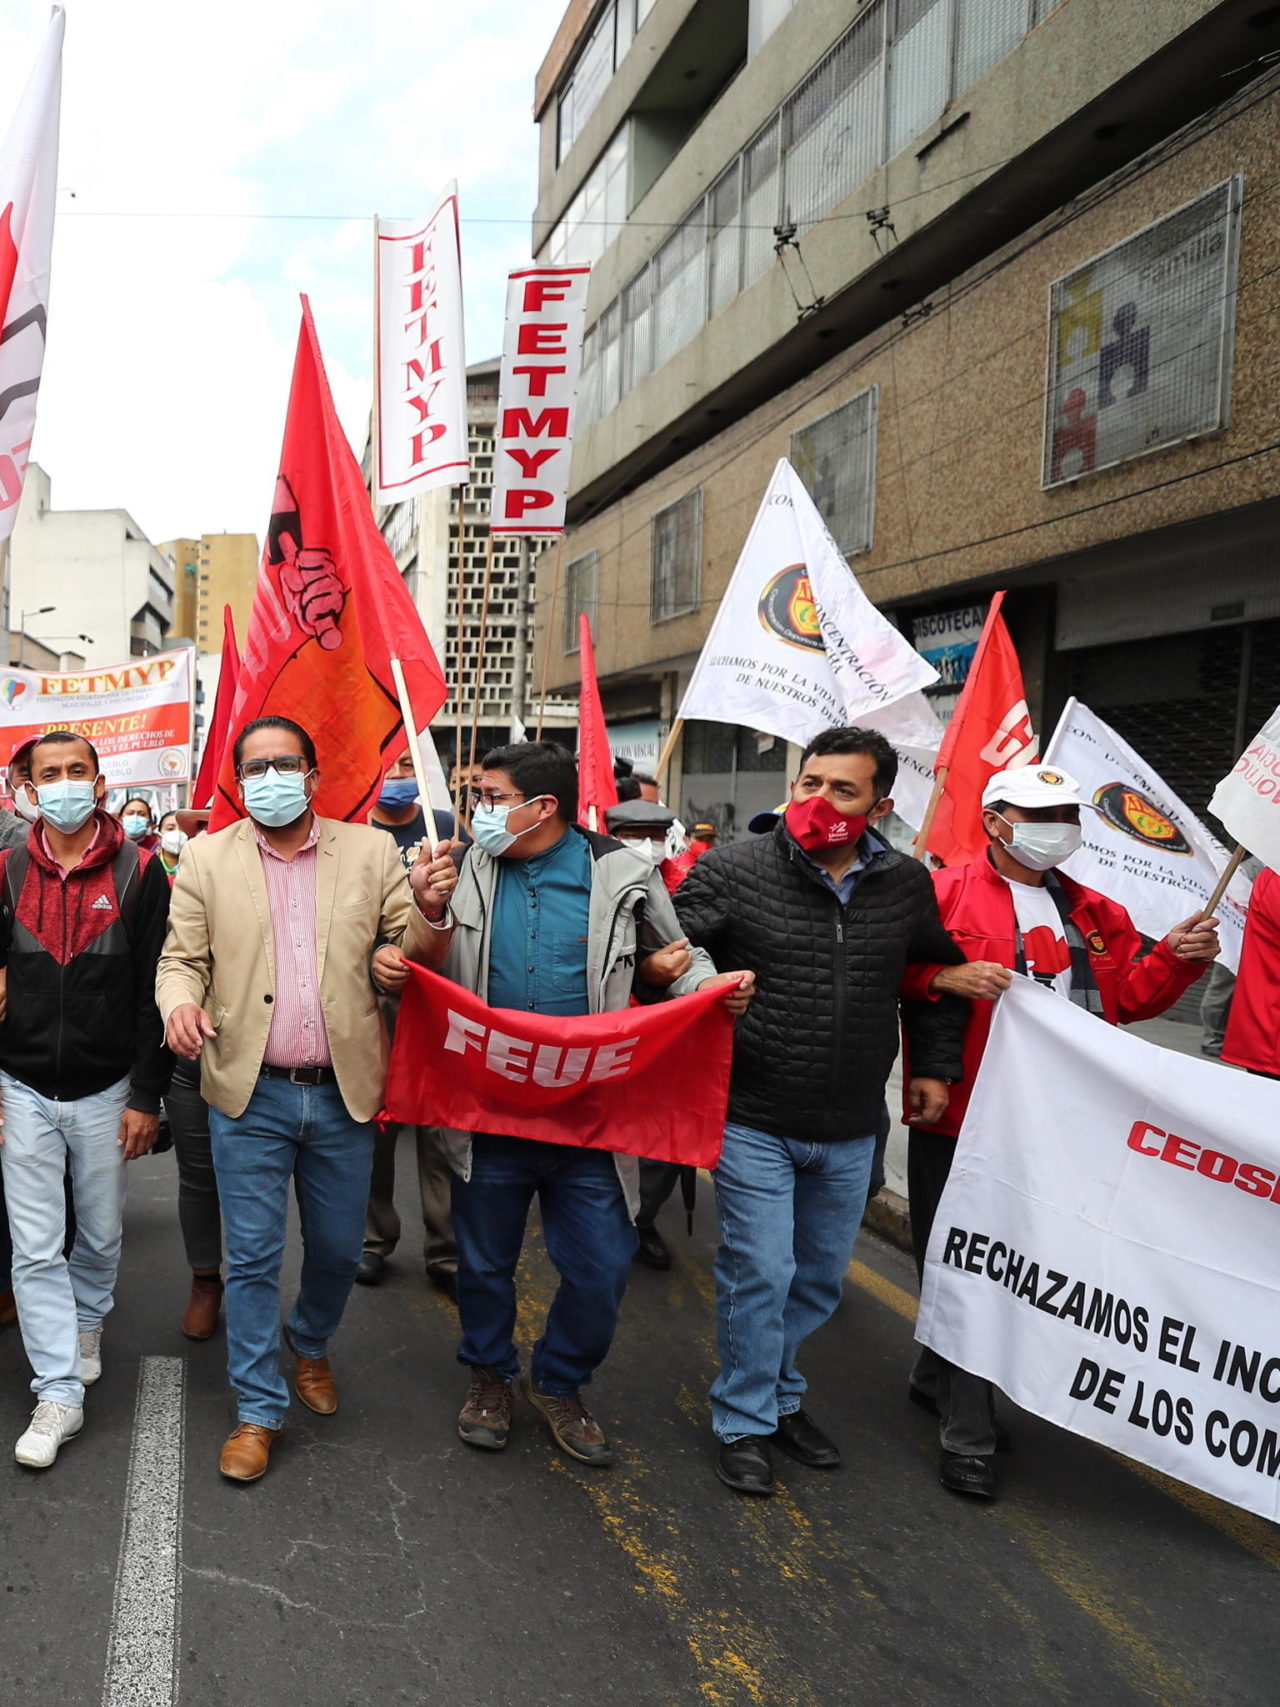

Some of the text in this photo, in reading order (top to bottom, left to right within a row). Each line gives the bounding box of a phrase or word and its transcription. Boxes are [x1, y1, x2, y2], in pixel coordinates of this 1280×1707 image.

[401, 225, 452, 469] FETMYP
[502, 280, 572, 519] FETMYP
[913, 607, 982, 638] DISCOTECA
[38, 660, 176, 695] FETMYP
[735, 673, 753, 685] DE
[755, 676, 817, 708] NUESTROS
[762, 662, 788, 679] POR
[791, 670, 807, 687] LA
[812, 683, 837, 707] VIDA
[1098, 856, 1196, 895] DE NUESTROS
[1123, 854, 1152, 869] POR
[1159, 864, 1175, 878] LA
[444, 1008, 640, 1088] FEUE
[943, 1227, 1280, 1404] RECHAZAMOS EL INC
[1069, 1357, 1280, 1481] DE LOS COM
